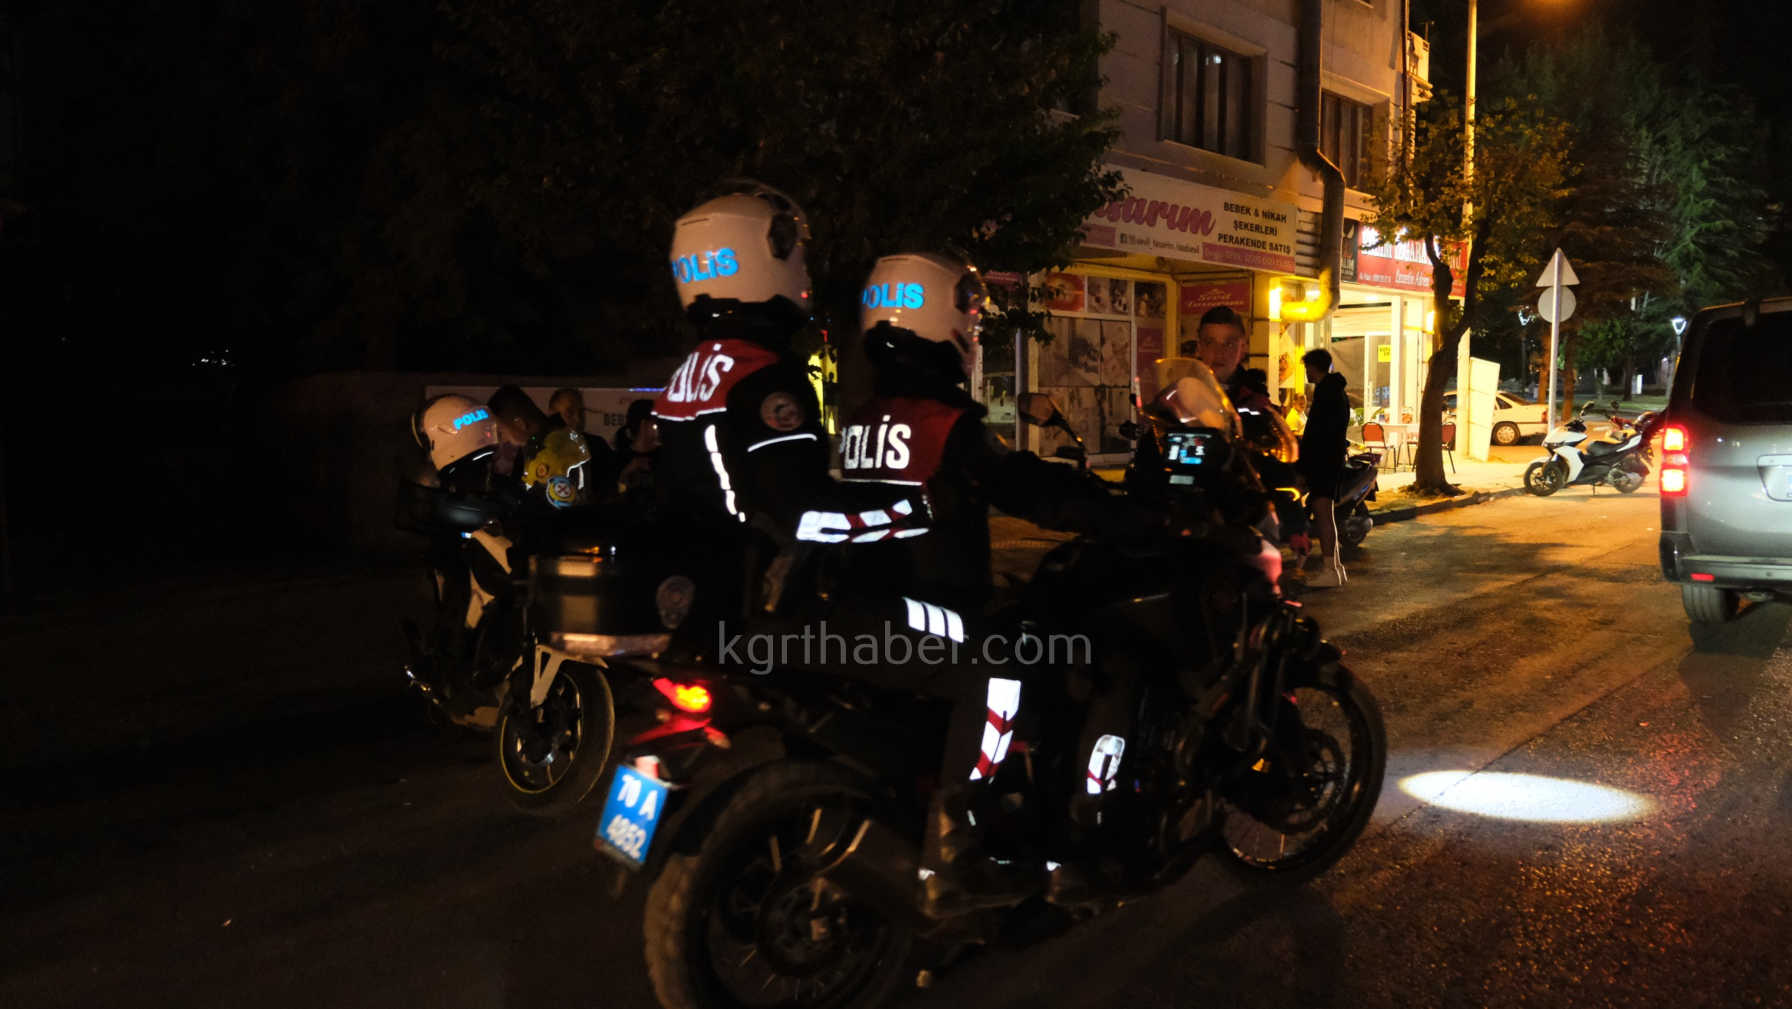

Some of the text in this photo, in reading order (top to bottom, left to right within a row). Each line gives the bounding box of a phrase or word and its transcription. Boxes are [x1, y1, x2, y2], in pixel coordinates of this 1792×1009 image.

[1095, 195, 1216, 236] sarım
[1223, 201, 1252, 216] BEBEK
[1217, 233, 1267, 250] PERAKENDE
[666, 343, 735, 402] OLİS
[638, 790, 658, 820] A
